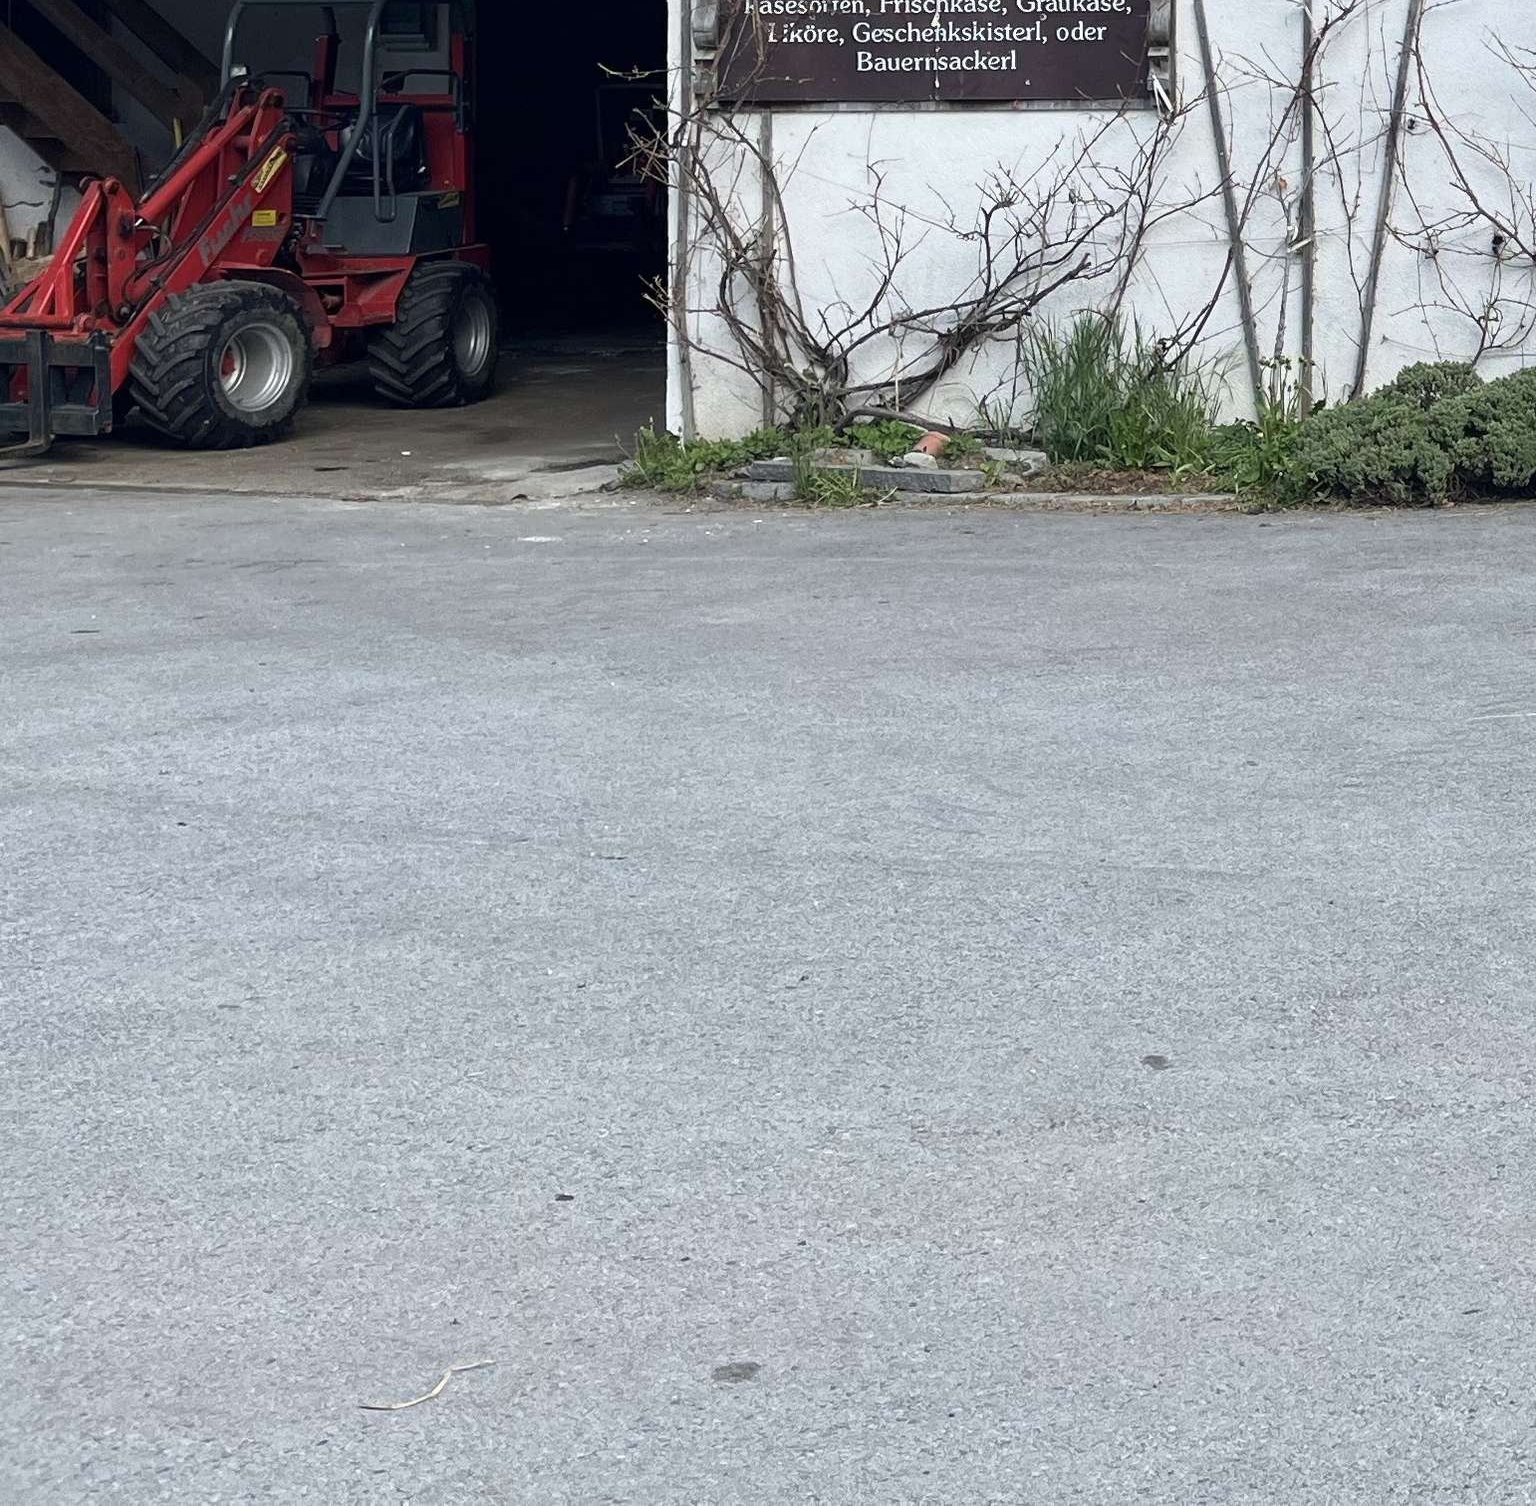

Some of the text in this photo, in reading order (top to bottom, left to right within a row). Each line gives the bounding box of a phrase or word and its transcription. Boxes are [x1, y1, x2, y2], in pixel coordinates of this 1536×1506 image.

[852, 20, 1048, 44] Geschenkskisterl,
[1056, 20, 1107, 42] oder
[856, 50, 1017, 71] Bauernsackerl
